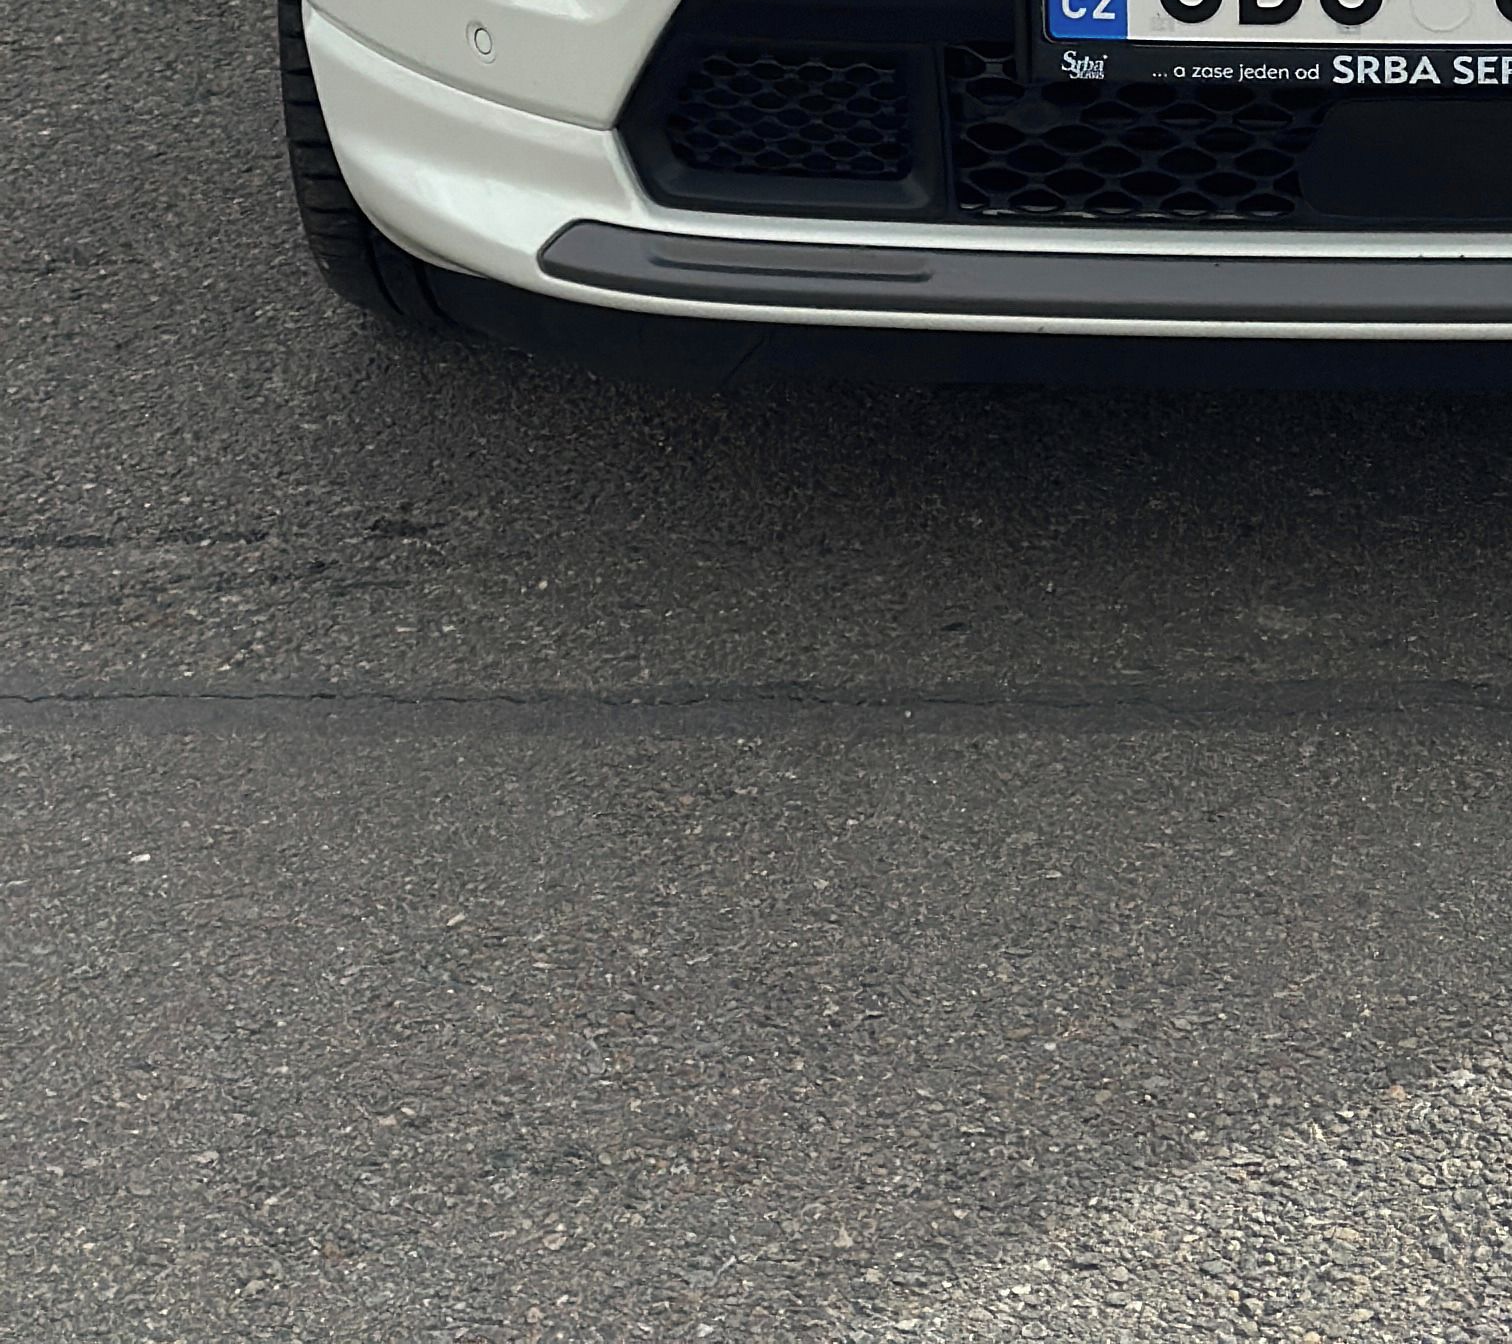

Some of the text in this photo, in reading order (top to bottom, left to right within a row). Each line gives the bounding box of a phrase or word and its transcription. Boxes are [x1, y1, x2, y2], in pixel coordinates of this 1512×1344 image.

[1173, 66, 1186, 78] a
[1191, 66, 1234, 79] zase
[1238, 63, 1290, 83] jeden
[1294, 63, 1320, 80] od
[1332, 55, 1441, 85] SRBA
